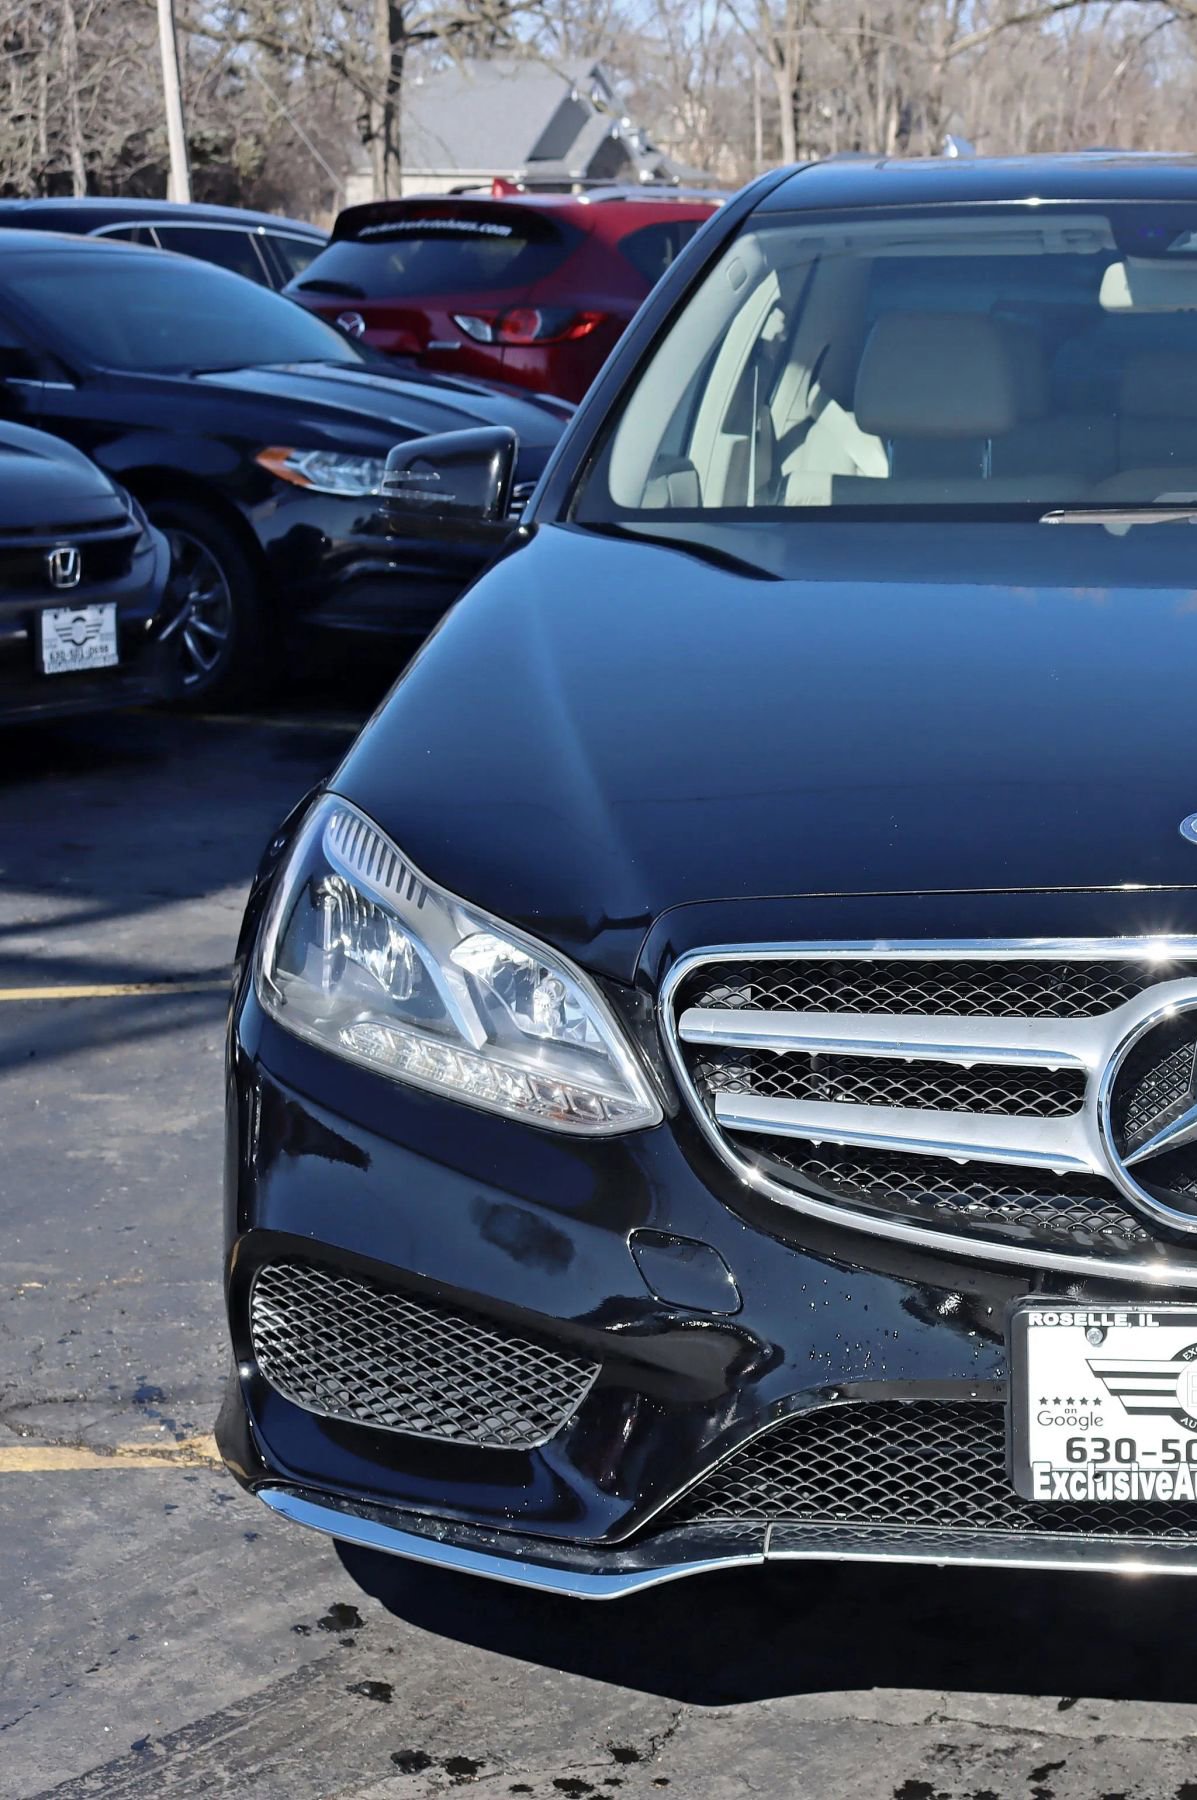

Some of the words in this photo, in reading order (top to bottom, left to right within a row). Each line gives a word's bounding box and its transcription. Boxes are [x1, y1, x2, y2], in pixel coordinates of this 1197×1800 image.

[1028, 1312, 1133, 1328] ROSELLE,
[1138, 1313, 1160, 1327] IL
[1036, 1410, 1104, 1431] Google
